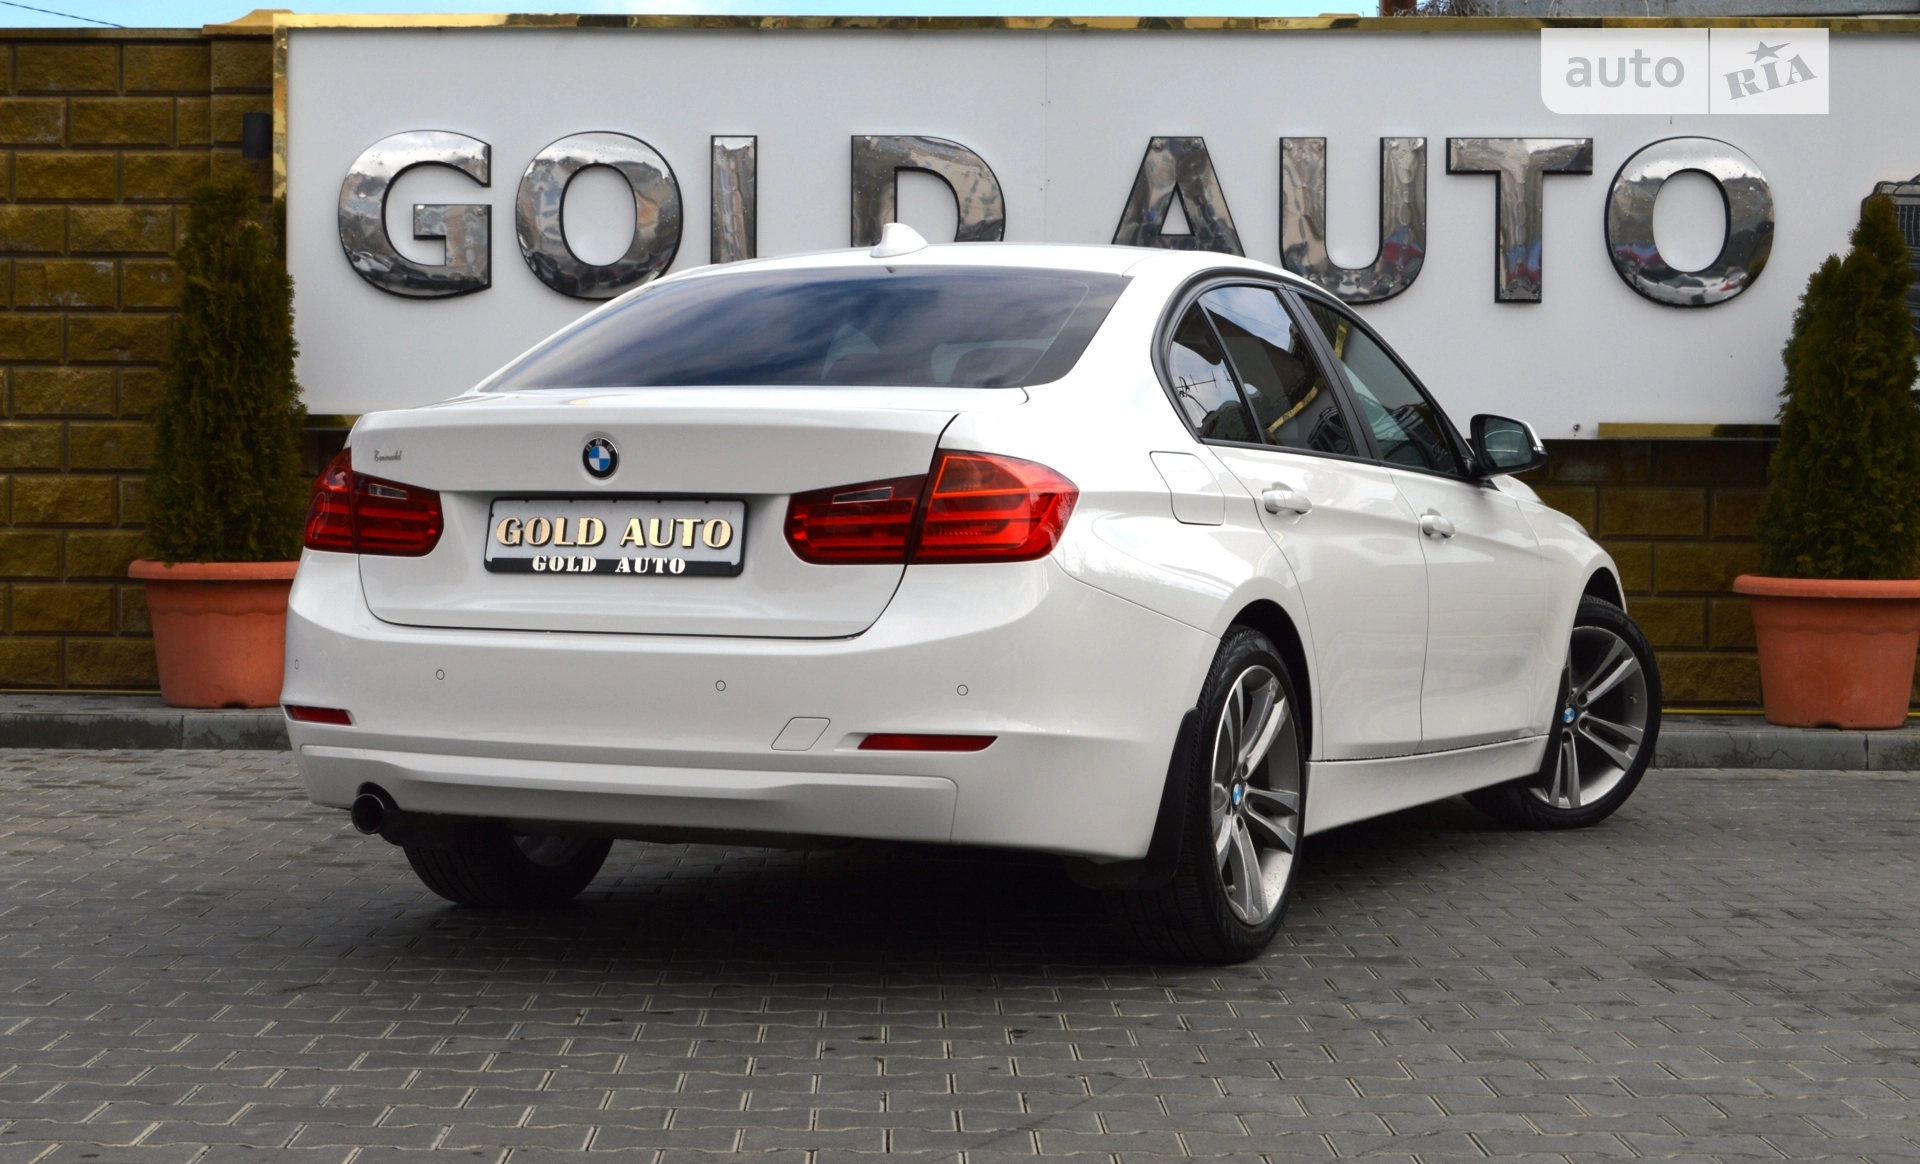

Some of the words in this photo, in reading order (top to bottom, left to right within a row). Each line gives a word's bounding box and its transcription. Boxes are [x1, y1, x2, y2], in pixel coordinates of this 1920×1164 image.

[1111, 136, 1775, 307] AUTO
[585, 438, 615, 453] BMW
[496, 516, 607, 547] GOLD
[619, 517, 734, 551] AUTO
[532, 554, 597, 573] GOLD
[615, 556, 686, 575] AUTO
